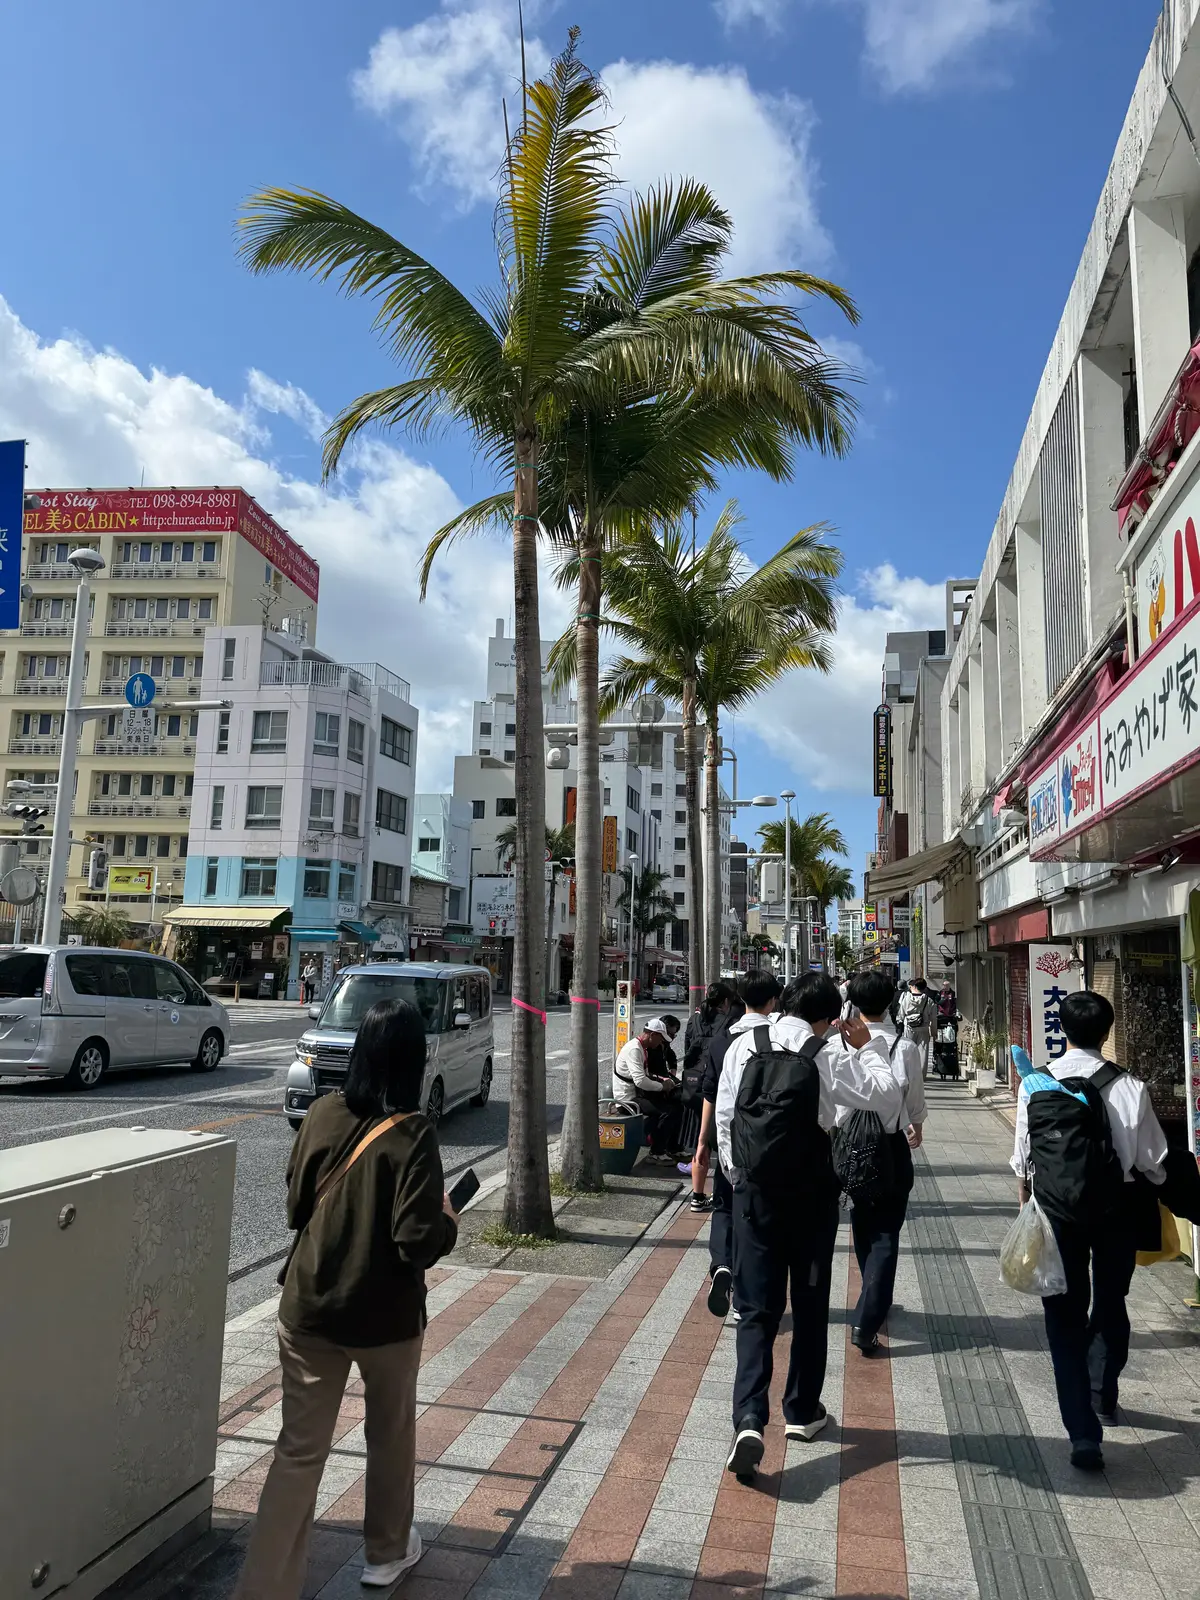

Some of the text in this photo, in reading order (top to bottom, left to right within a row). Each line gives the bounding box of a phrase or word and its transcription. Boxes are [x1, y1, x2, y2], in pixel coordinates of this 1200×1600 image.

[62, 492, 99, 511] Stay
[129, 493, 237, 508] TEL 098-894-8981
[23, 513, 43, 530] EL
[74, 512, 128, 529] CABIN
[143, 511, 234, 529] http:churacabin.jp
[274, 528, 287, 550] Stay
[1104, 643, 1199, 788] おみやげ家
[868, 922, 874, 930] 6
[1043, 986, 1068, 1065] 大栄サ
